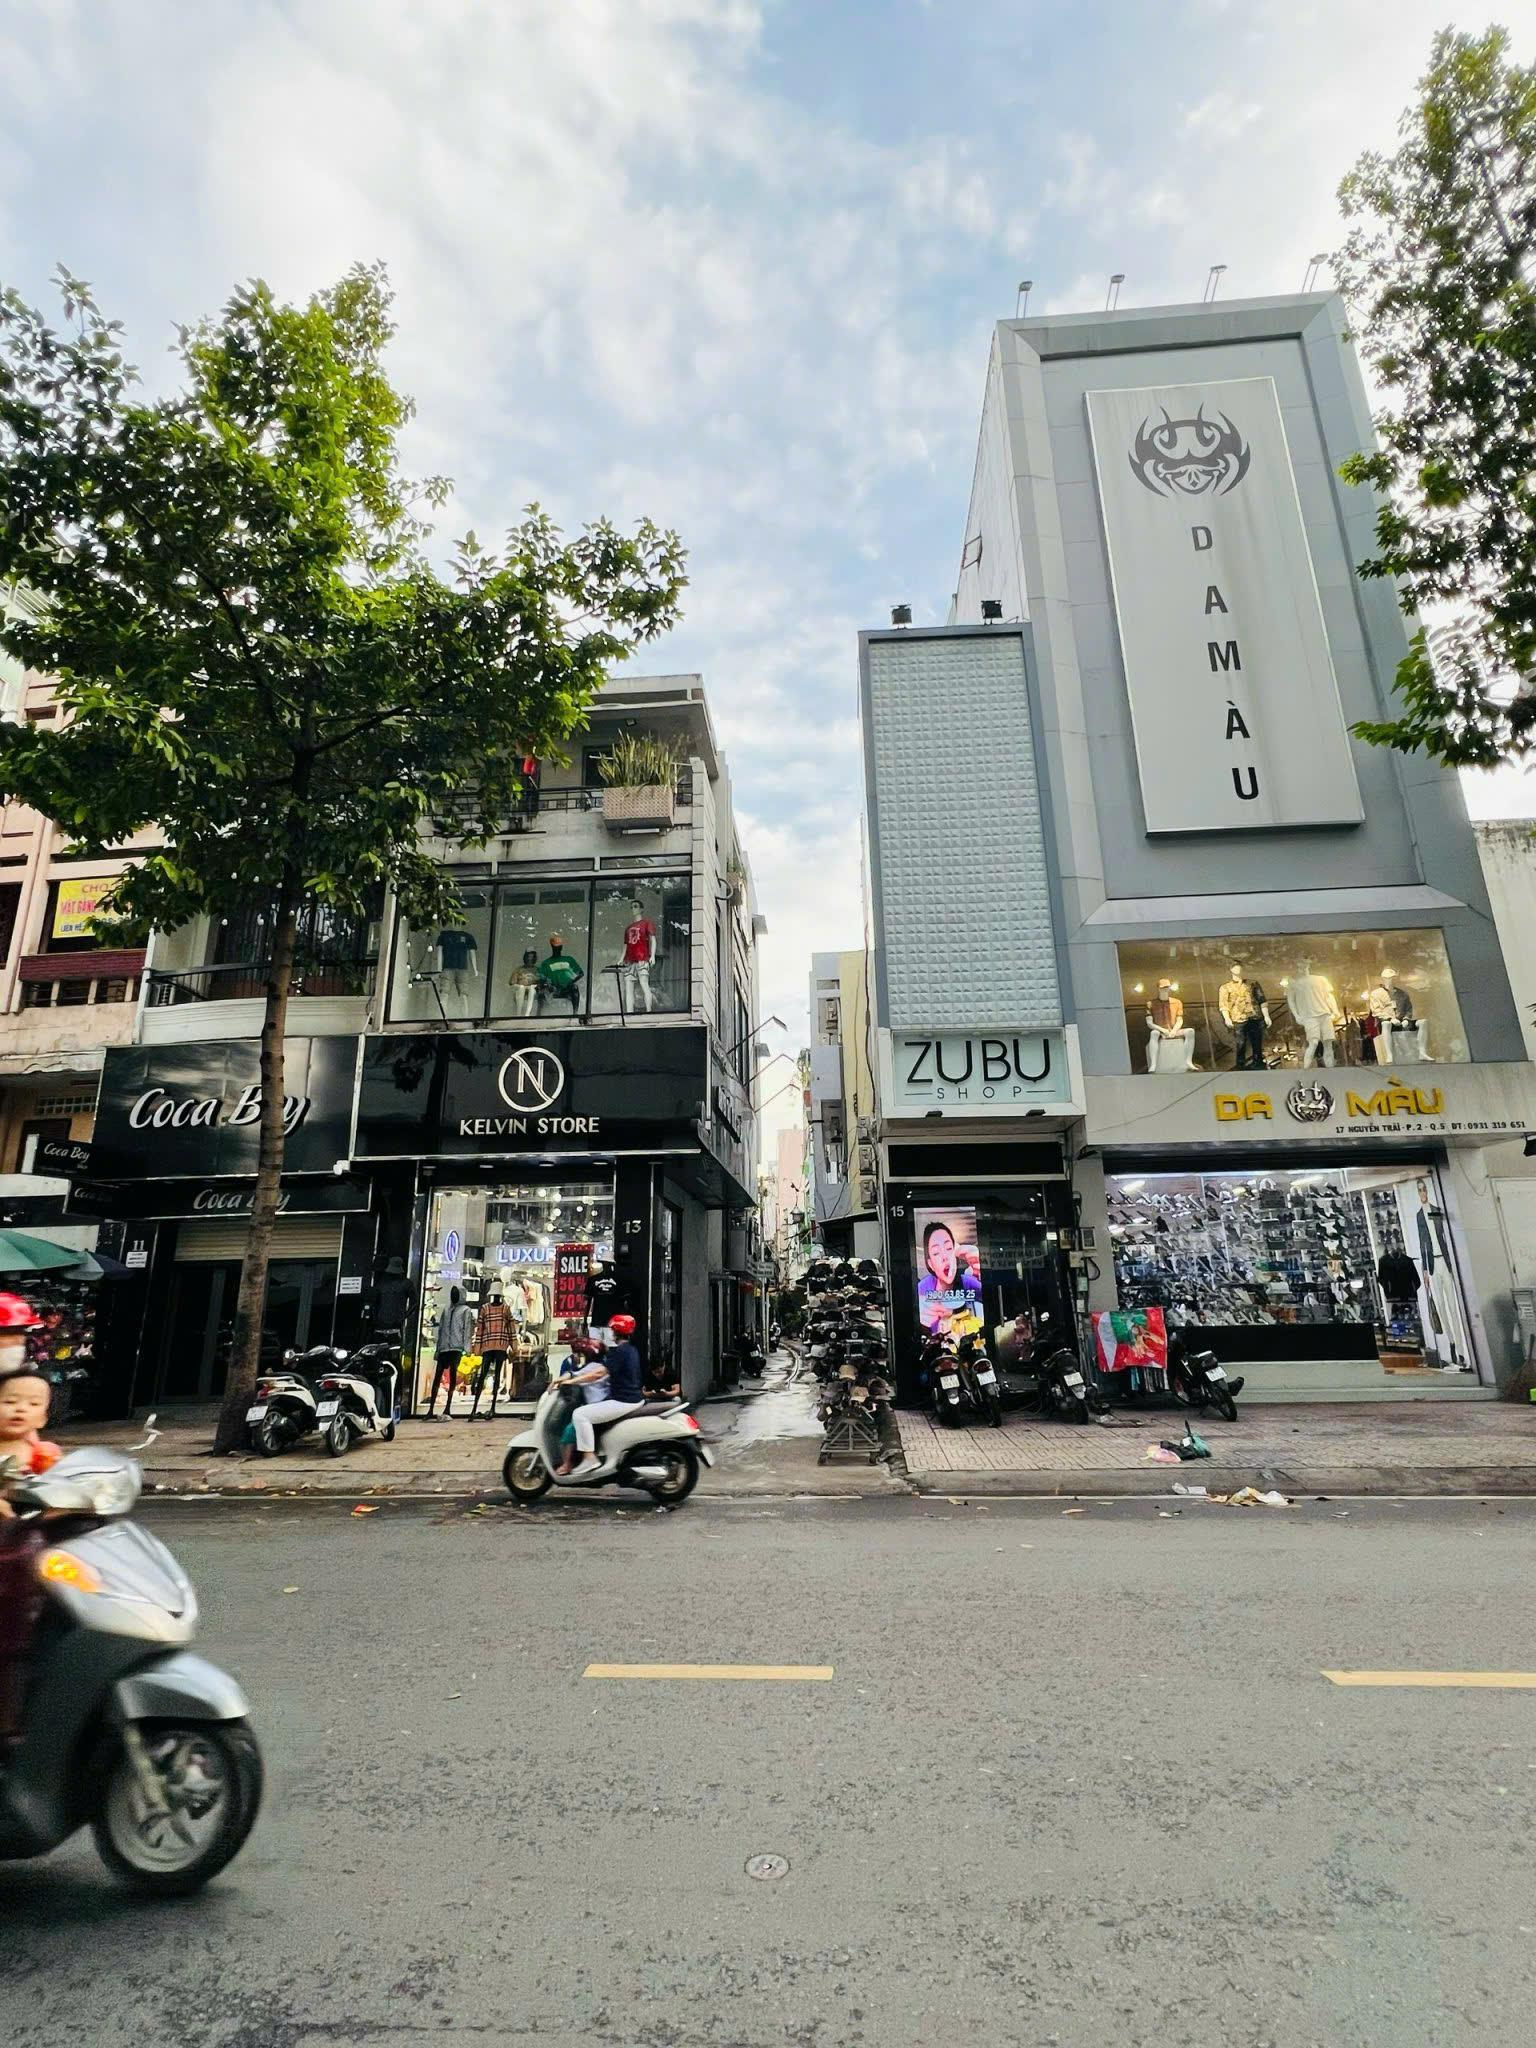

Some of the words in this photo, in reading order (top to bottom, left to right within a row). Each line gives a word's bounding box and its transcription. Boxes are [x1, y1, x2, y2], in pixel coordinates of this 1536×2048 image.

[904, 1038, 1051, 1084] ZUBU
[937, 1086, 1022, 1099] SHOP
[1215, 1094, 1273, 1121] DA
[1346, 1074, 1441, 1117] MÀU
[129, 1088, 219, 1129] Coca
[227, 1084, 308, 1136] By
[460, 1118, 527, 1136] KELVIN
[537, 1116, 600, 1134] STORE
[1336, 1126, 1344, 1134] 17
[1492, 1121, 1507, 1129] 319
[1510, 1120, 1526, 1129] 651
[44, 1142, 69, 1157] Coca
[70, 1146, 90, 1163] Boy
[193, 1189, 242, 1210] Coca
[890, 1206, 904, 1217] 15
[623, 1220, 641, 1234] 13
[133, 1240, 145, 1251] 11
[497, 1247, 557, 1263] LUXUR
[560, 1256, 589, 1274] SALE
[560, 1276, 587, 1292] 50%
[559, 1294, 587, 1310] 70%
